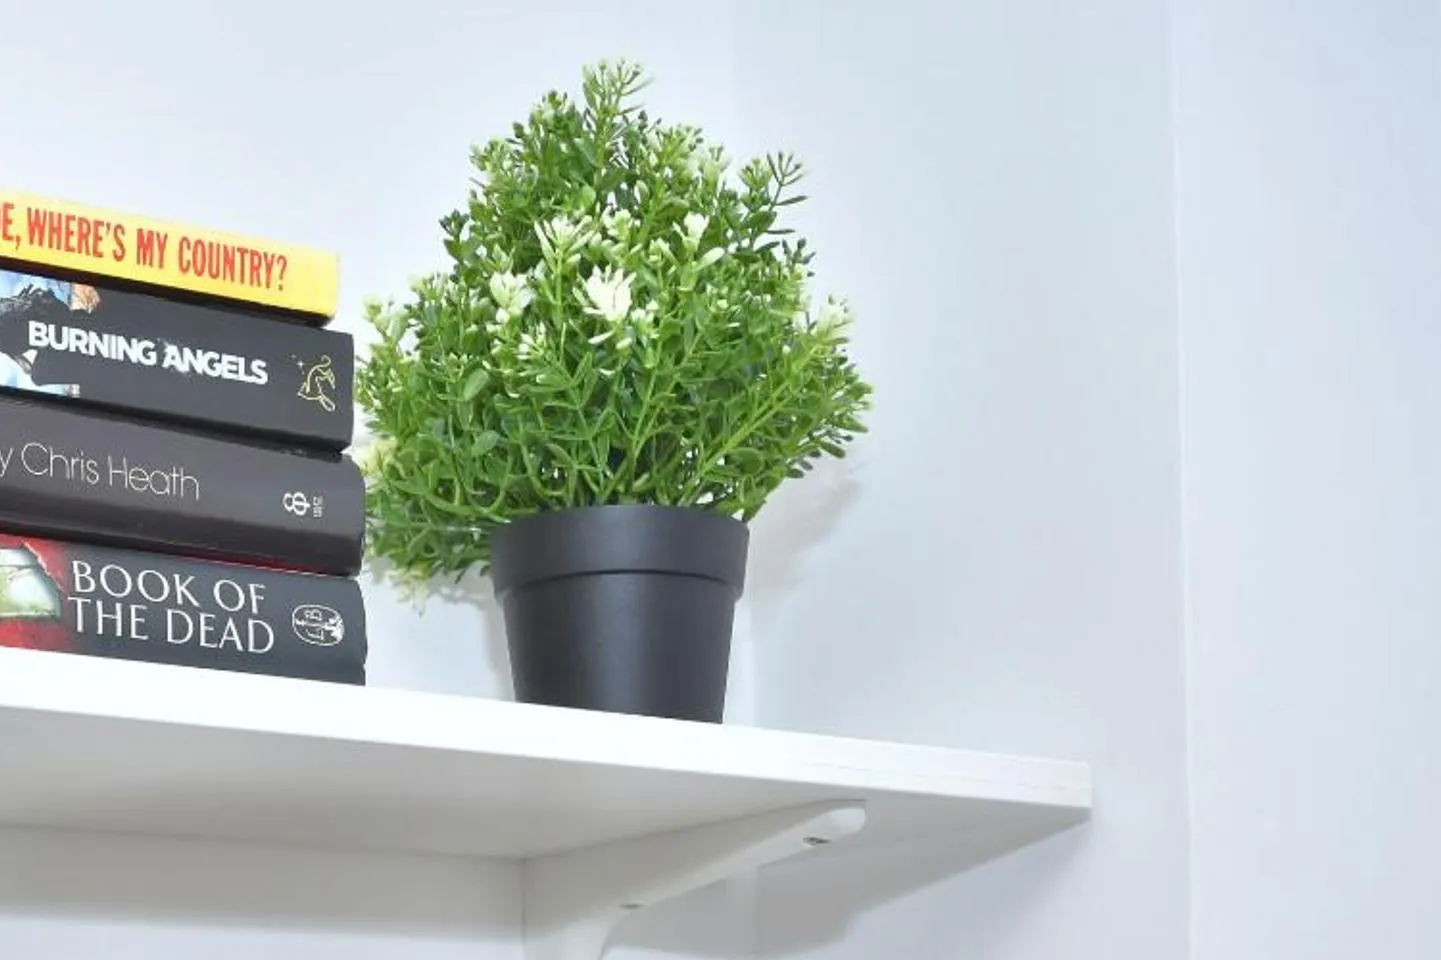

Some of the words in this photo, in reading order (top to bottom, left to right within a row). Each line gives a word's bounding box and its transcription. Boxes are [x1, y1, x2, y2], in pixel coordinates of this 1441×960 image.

[27, 206, 126, 262] WHERE'S
[136, 228, 168, 268] MY
[177, 235, 288, 292] COUNTRY?
[27, 319, 158, 368] BURNING
[161, 343, 269, 386] ANGELS
[21, 441, 100, 486] Chris
[109, 455, 201, 501] Heath
[71, 559, 202, 609] BOOK
[213, 579, 267, 615] OF
[67, 596, 149, 641] THE
[166, 610, 276, 655] DEAD
